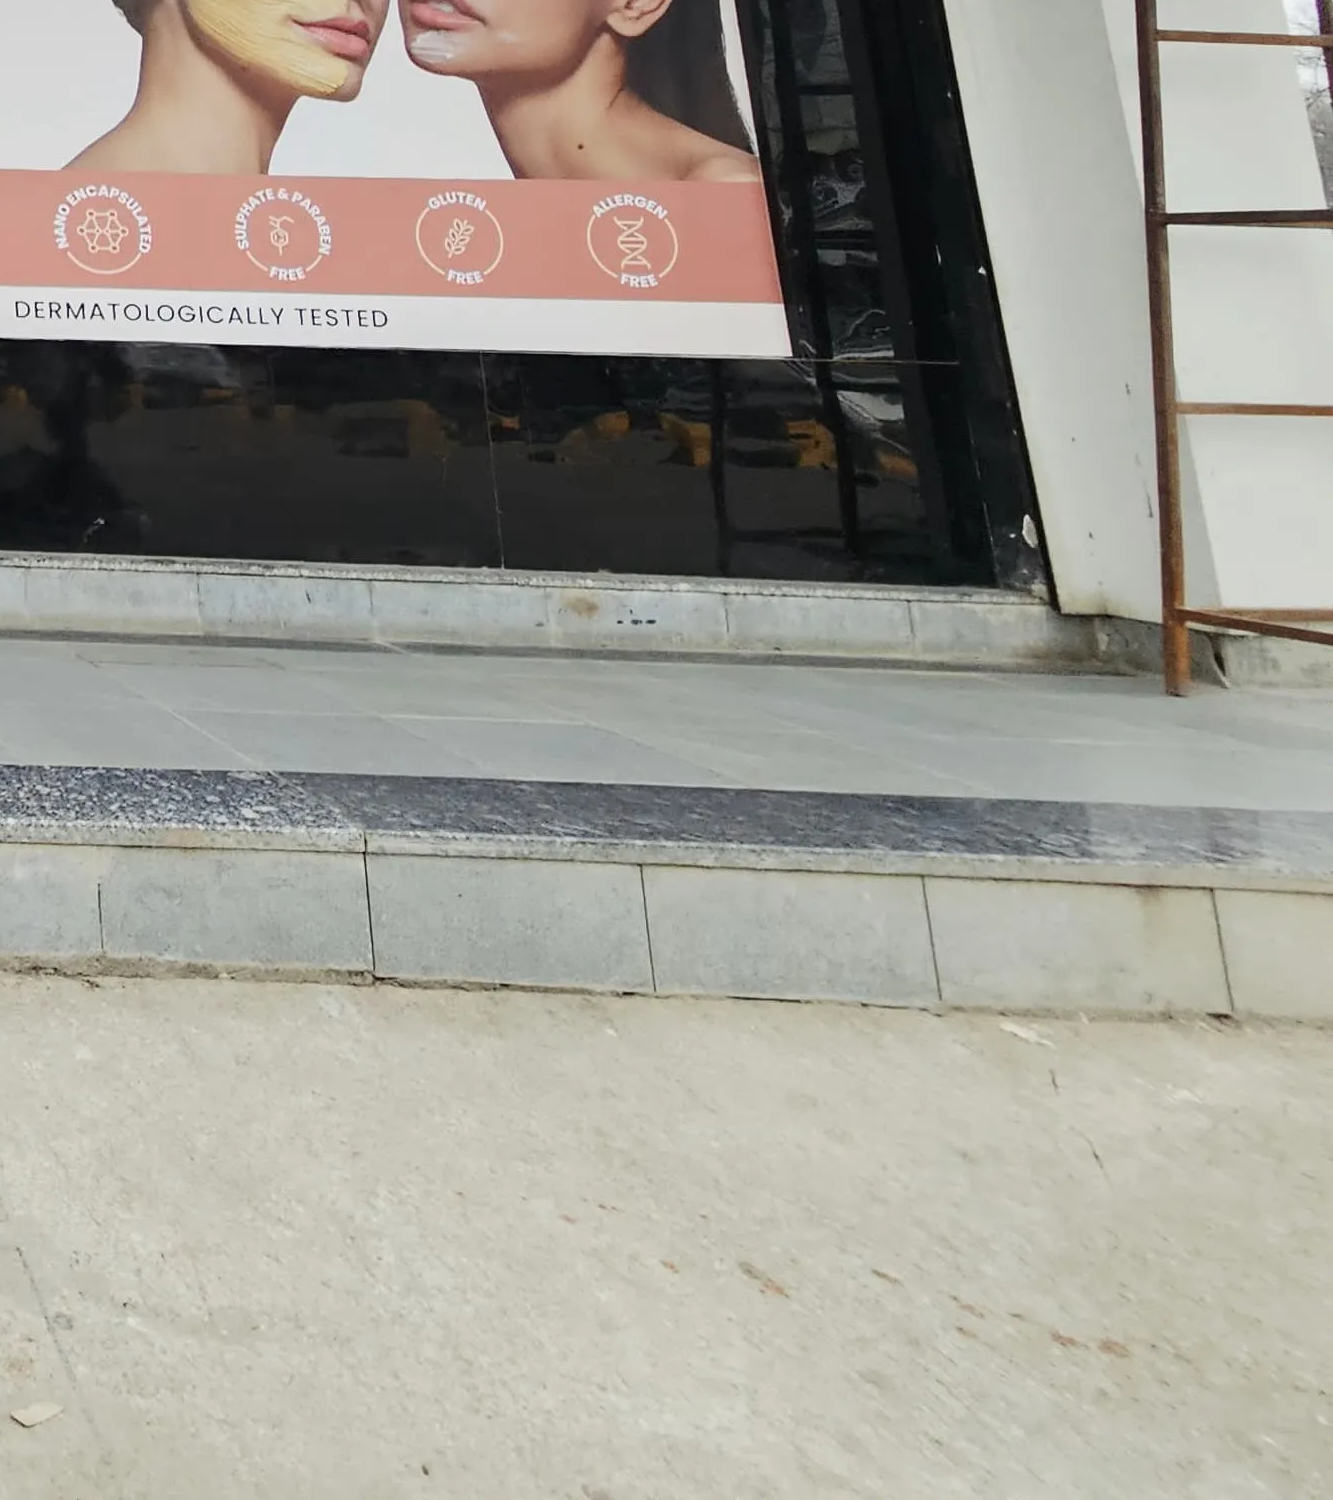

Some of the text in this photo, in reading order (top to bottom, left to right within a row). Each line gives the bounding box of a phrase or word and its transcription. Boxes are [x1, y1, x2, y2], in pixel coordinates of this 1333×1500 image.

[428, 191, 487, 212] GLUTEN
[592, 194, 668, 220] ALLERGEN
[53, 184, 152, 254] NANO ENCAPSULATED
[234, 187, 332, 256] SULPHATE & PARABEN
[269, 265, 307, 282] FREE
[446, 268, 485, 285] FREE
[620, 272, 659, 289] FREE
[15, 301, 389, 328] DERMATOLOGICALLY TESTED
